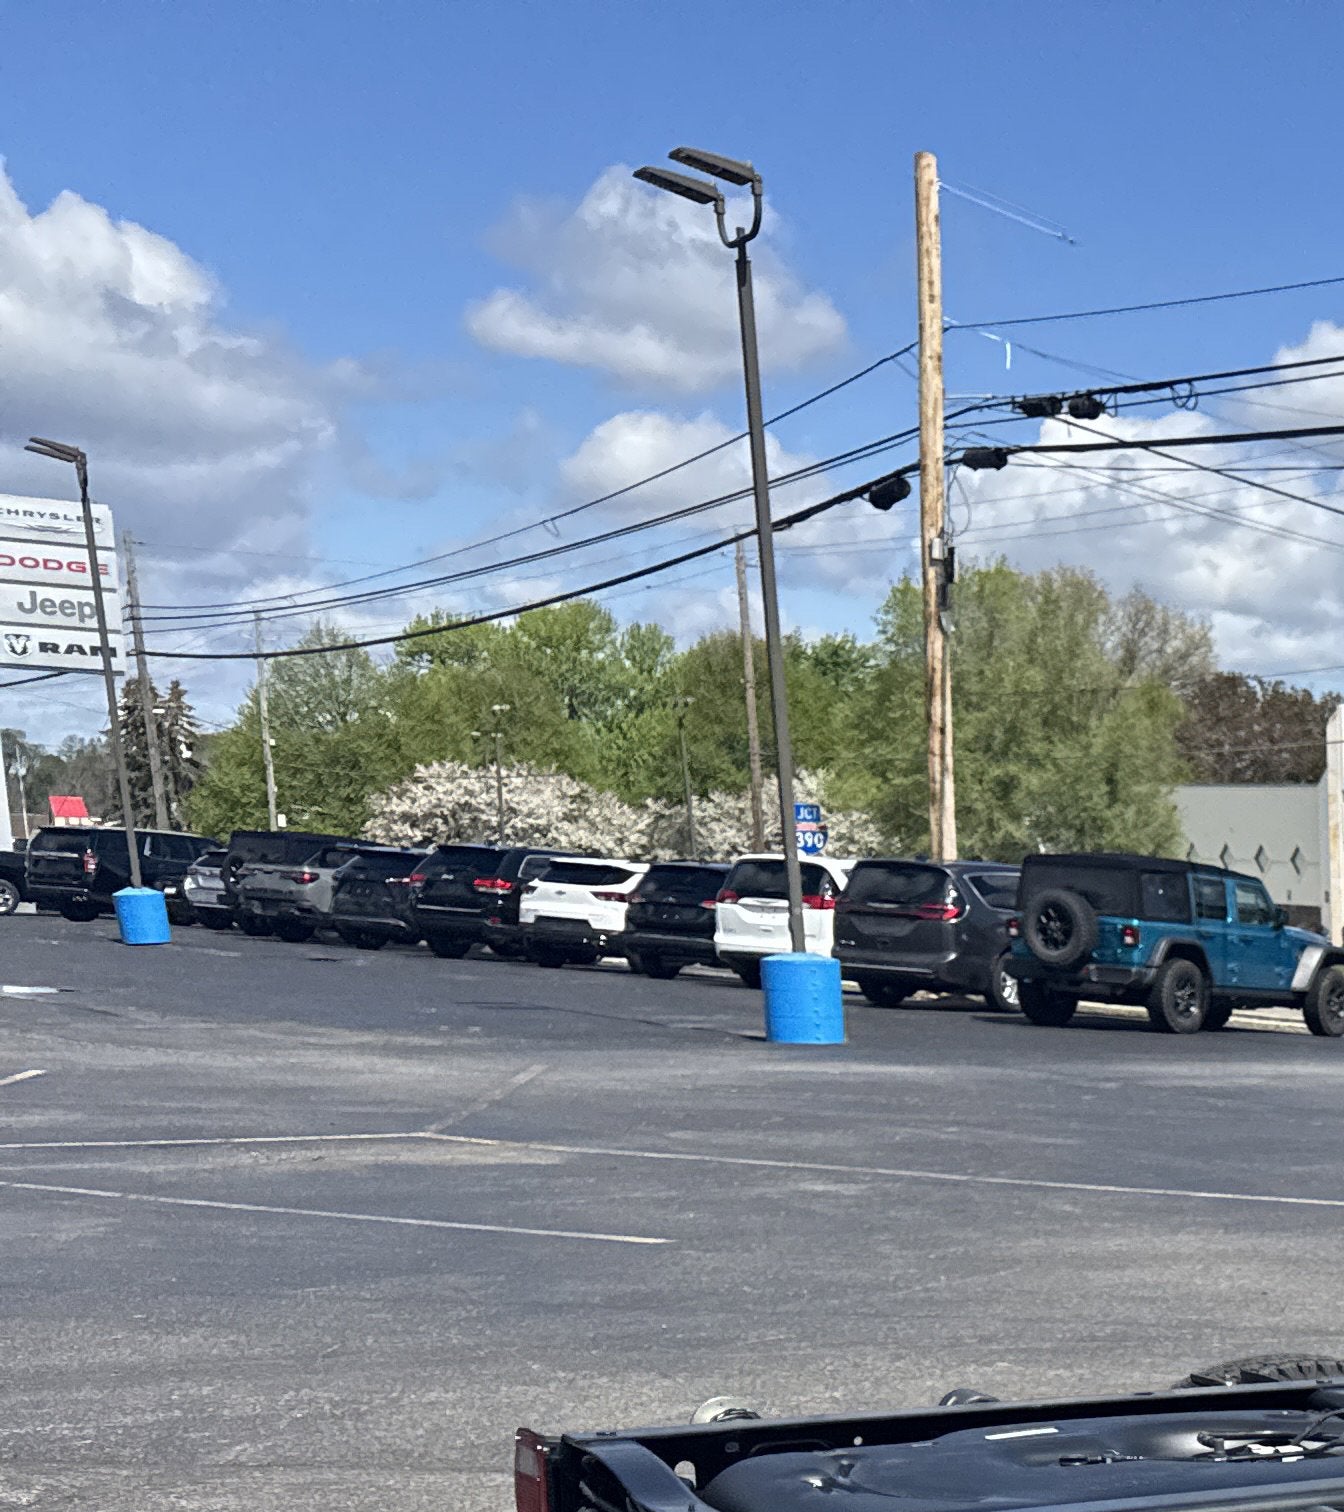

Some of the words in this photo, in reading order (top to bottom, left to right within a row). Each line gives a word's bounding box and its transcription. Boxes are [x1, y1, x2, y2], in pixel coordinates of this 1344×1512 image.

[16, 590, 97, 624] Jeep
[38, 642, 117, 658] RAM
[797, 806, 818, 820] JCT
[795, 831, 824, 848] 390
